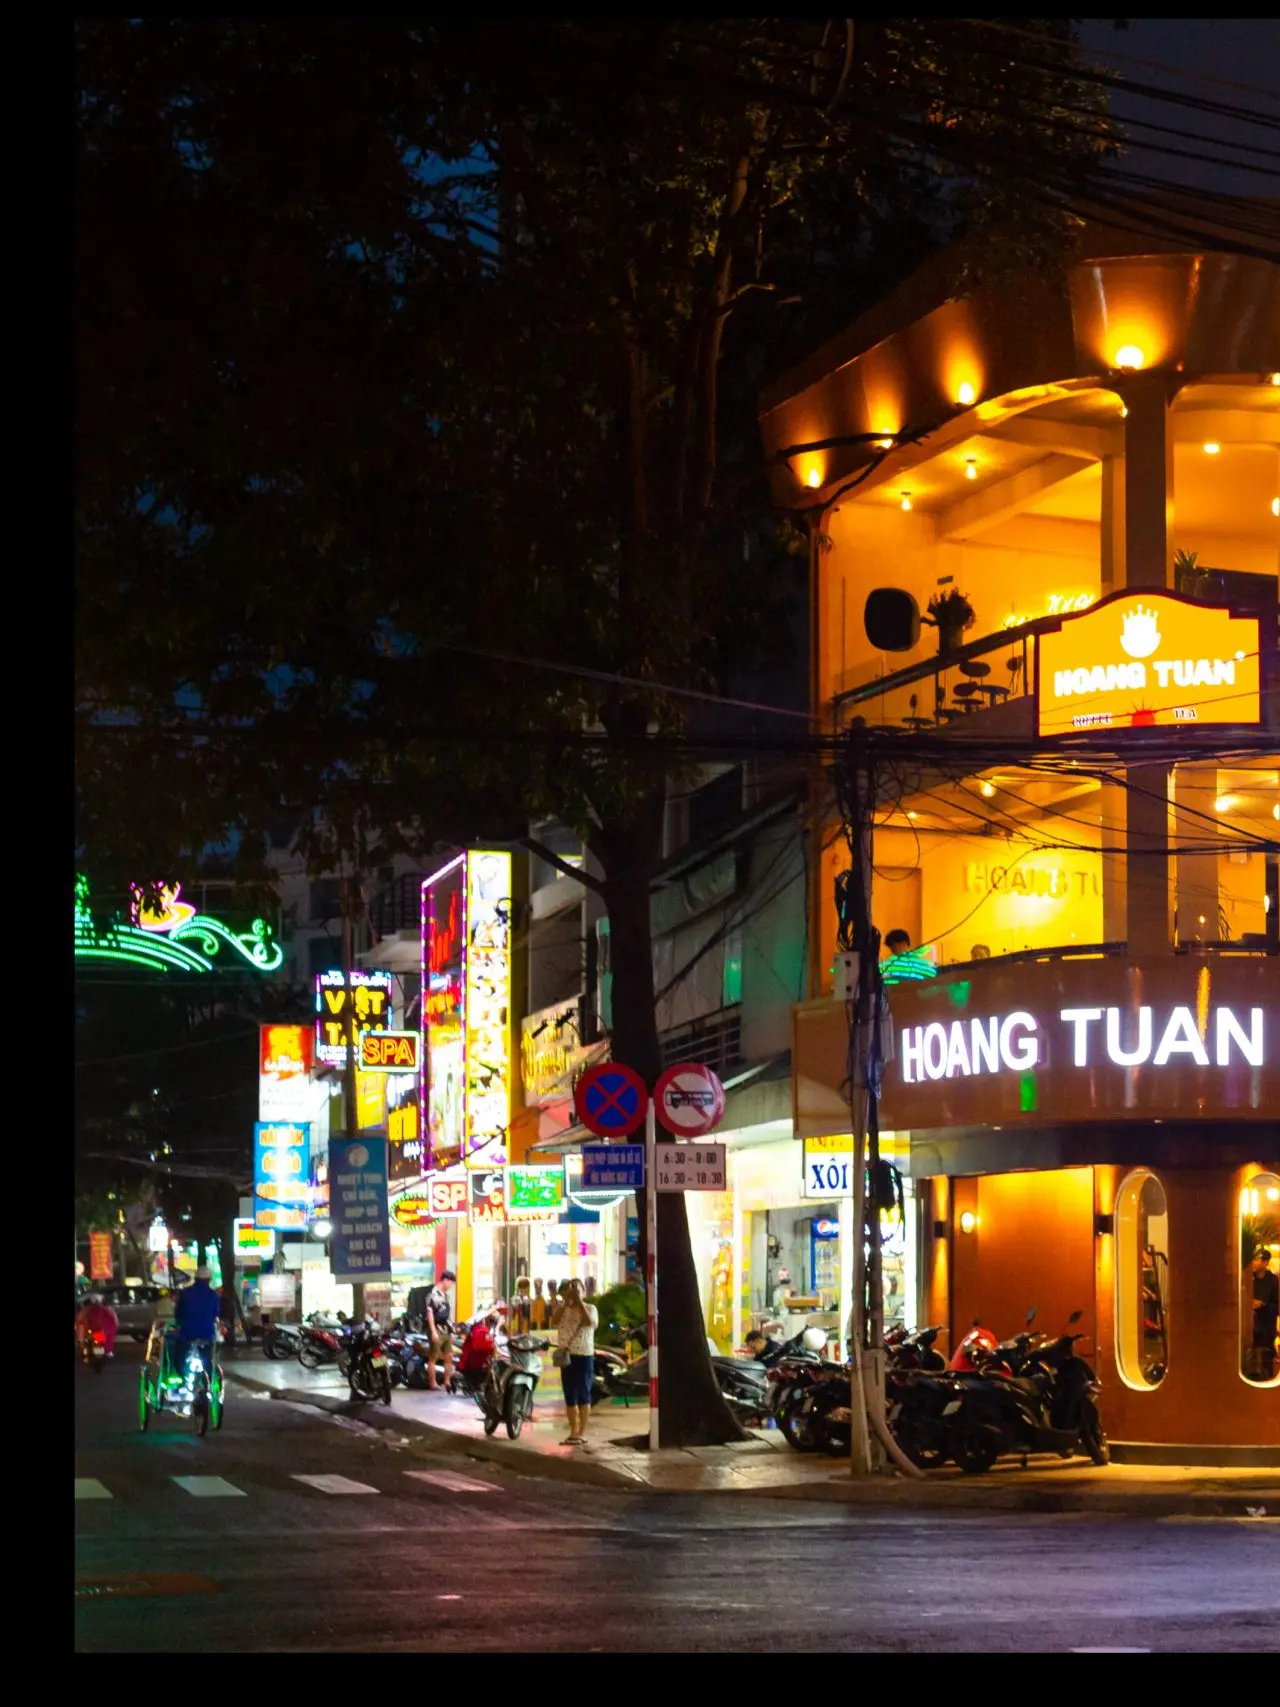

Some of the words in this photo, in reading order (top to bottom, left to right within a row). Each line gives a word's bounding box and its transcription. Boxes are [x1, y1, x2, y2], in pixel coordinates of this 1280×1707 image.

[1054, 662, 1146, 697] HOANG
[1153, 659, 1236, 688] TUAN
[325, 985, 385, 1020] VỆT
[364, 1037, 415, 1065] SPA
[902, 1011, 1039, 1083] HOANG
[1060, 1006, 1264, 1067] TUAN
[659, 1172, 686, 1185] 16:30
[812, 1157, 848, 1189] XÔI
